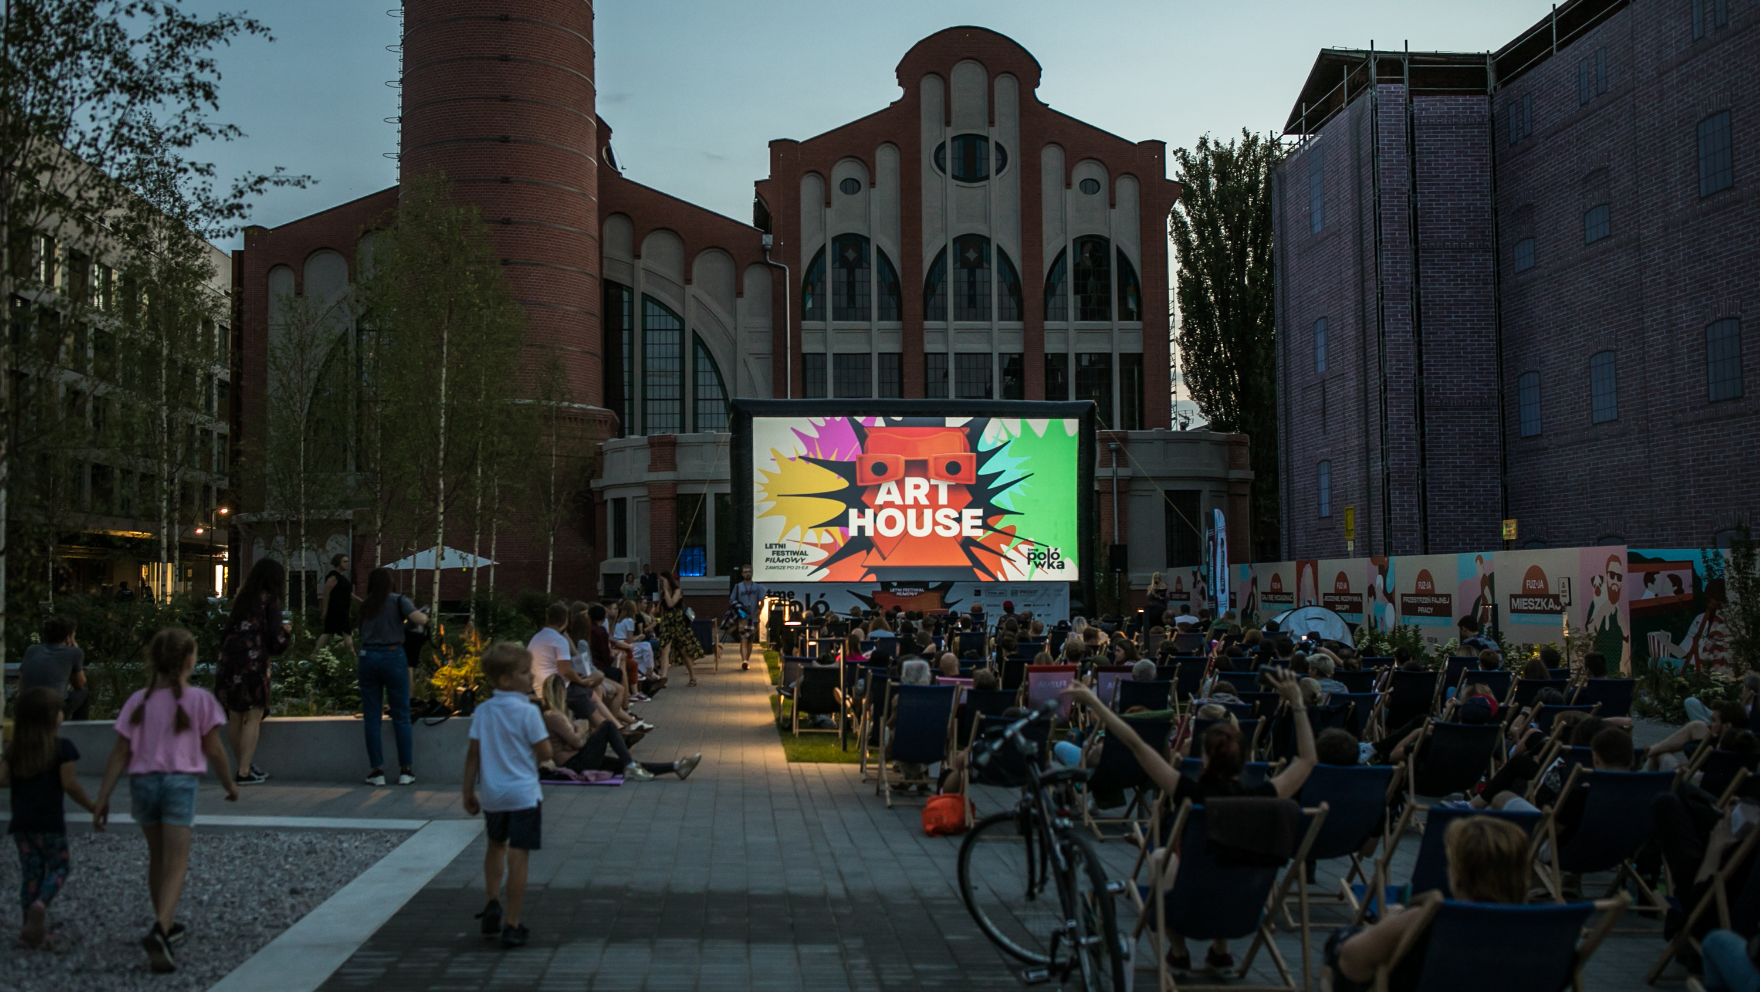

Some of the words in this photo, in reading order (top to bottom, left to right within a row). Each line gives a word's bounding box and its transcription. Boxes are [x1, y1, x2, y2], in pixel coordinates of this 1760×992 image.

[874, 477, 956, 505] ART
[848, 508, 984, 538] HOUSE
[1027, 548, 1060, 565] poló
[1417, 606, 1434, 614] PRACY
